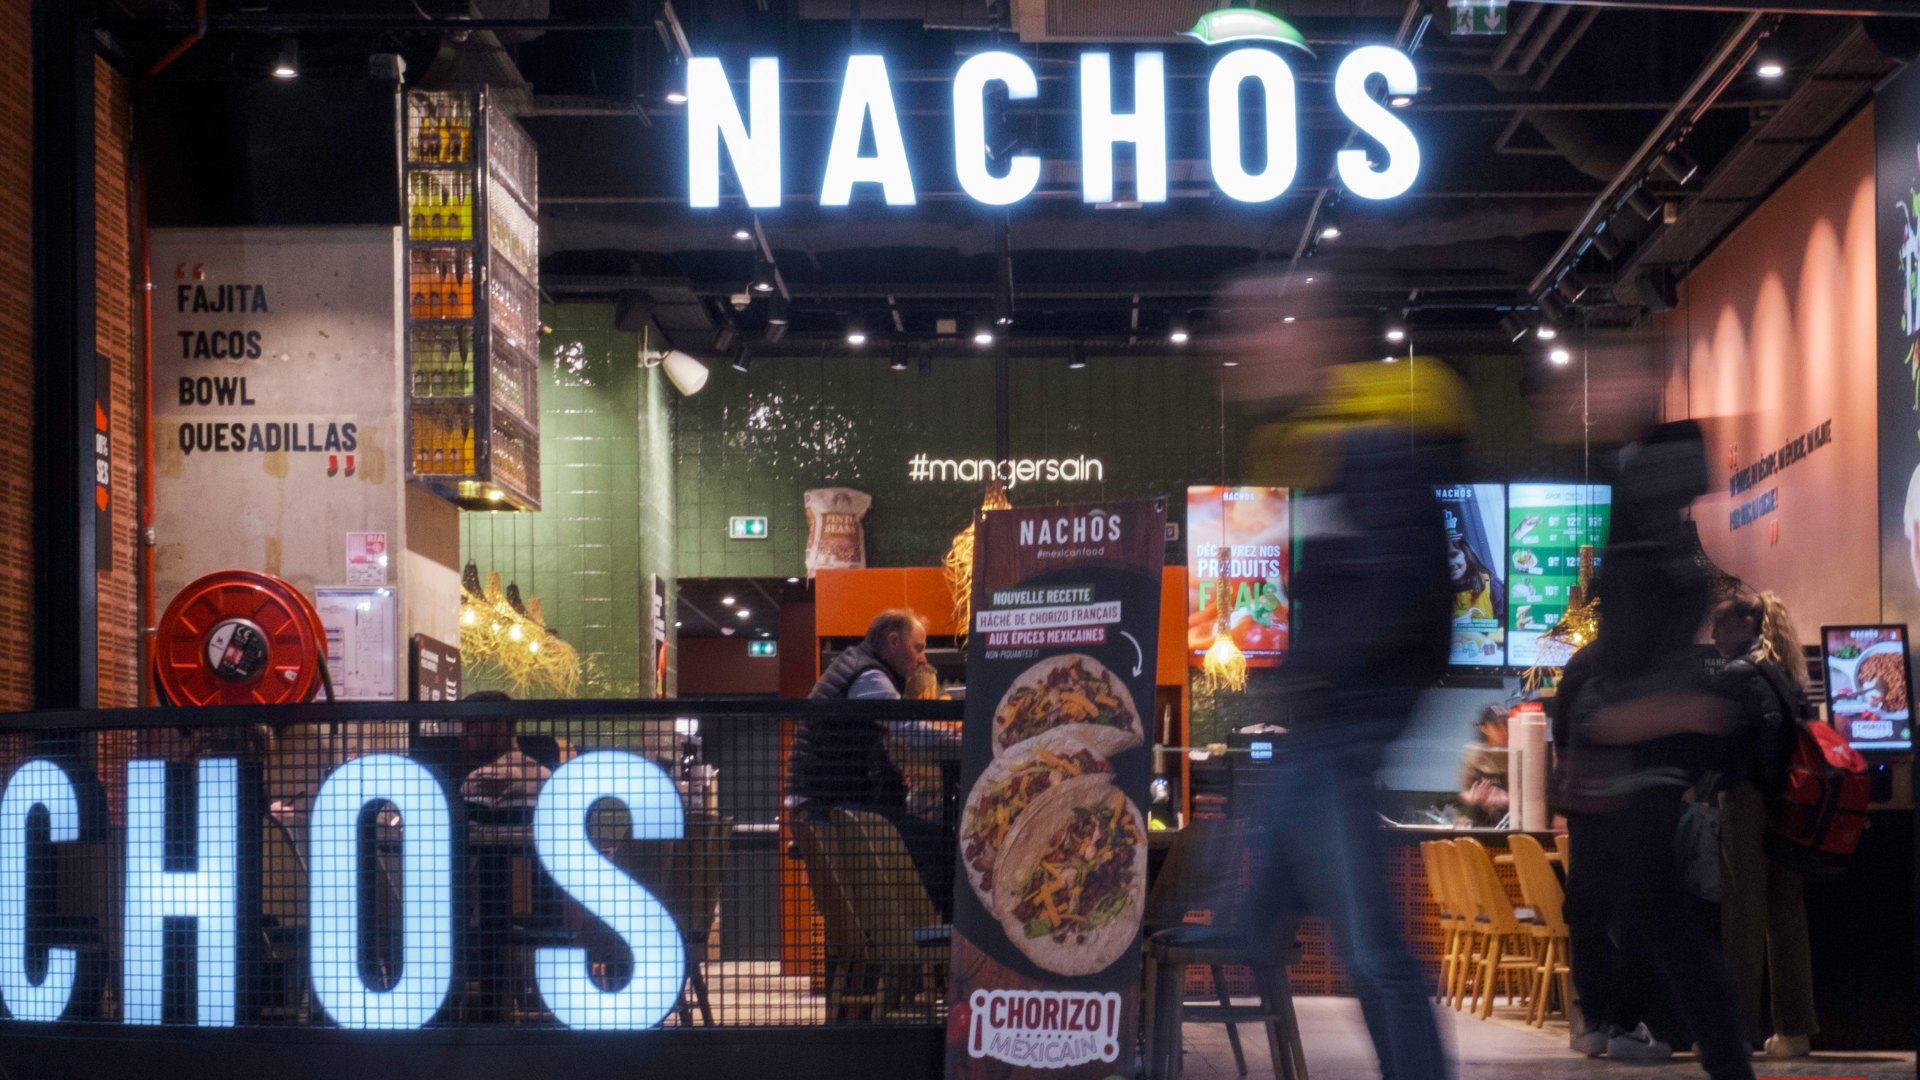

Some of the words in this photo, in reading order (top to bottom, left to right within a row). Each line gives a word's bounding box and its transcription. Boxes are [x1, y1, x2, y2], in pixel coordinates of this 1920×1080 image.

[686, 45, 1422, 208] NACHOS
[177, 284, 269, 313] FAJITA
[177, 330, 262, 359] TACOS
[178, 376, 256, 406] BOWL
[178, 422, 357, 456] QUESADILLAS
[908, 453, 1103, 490] #mangersain
[1222, 492, 1255, 501] NACHOS
[1435, 489, 1472, 498] NACHOS
[367, 534, 385, 543] RIA
[1019, 514, 1122, 546] NACHOS
[1036, 547, 1105, 559] #mexicanfood
[1197, 542, 1257, 557] DÉCVREZ
[1259, 545, 1281, 557] NOS
[1197, 559, 1280, 578] PRDUITS
[993, 590, 1044, 606] NOUVELLE
[1046, 588, 1091, 603] RECETTE
[1014, 614, 1026, 626] DE
[1029, 611, 1069, 624] CHORIZO
[1071, 606, 1118, 622] FRANÇAIS
[988, 632, 1009, 645] AUX
[1011, 629, 1045, 644] ÉPICES
[1047, 628, 1105, 643] MEXICAINES
[989, 1032, 1098, 1063] MEXICAIN
